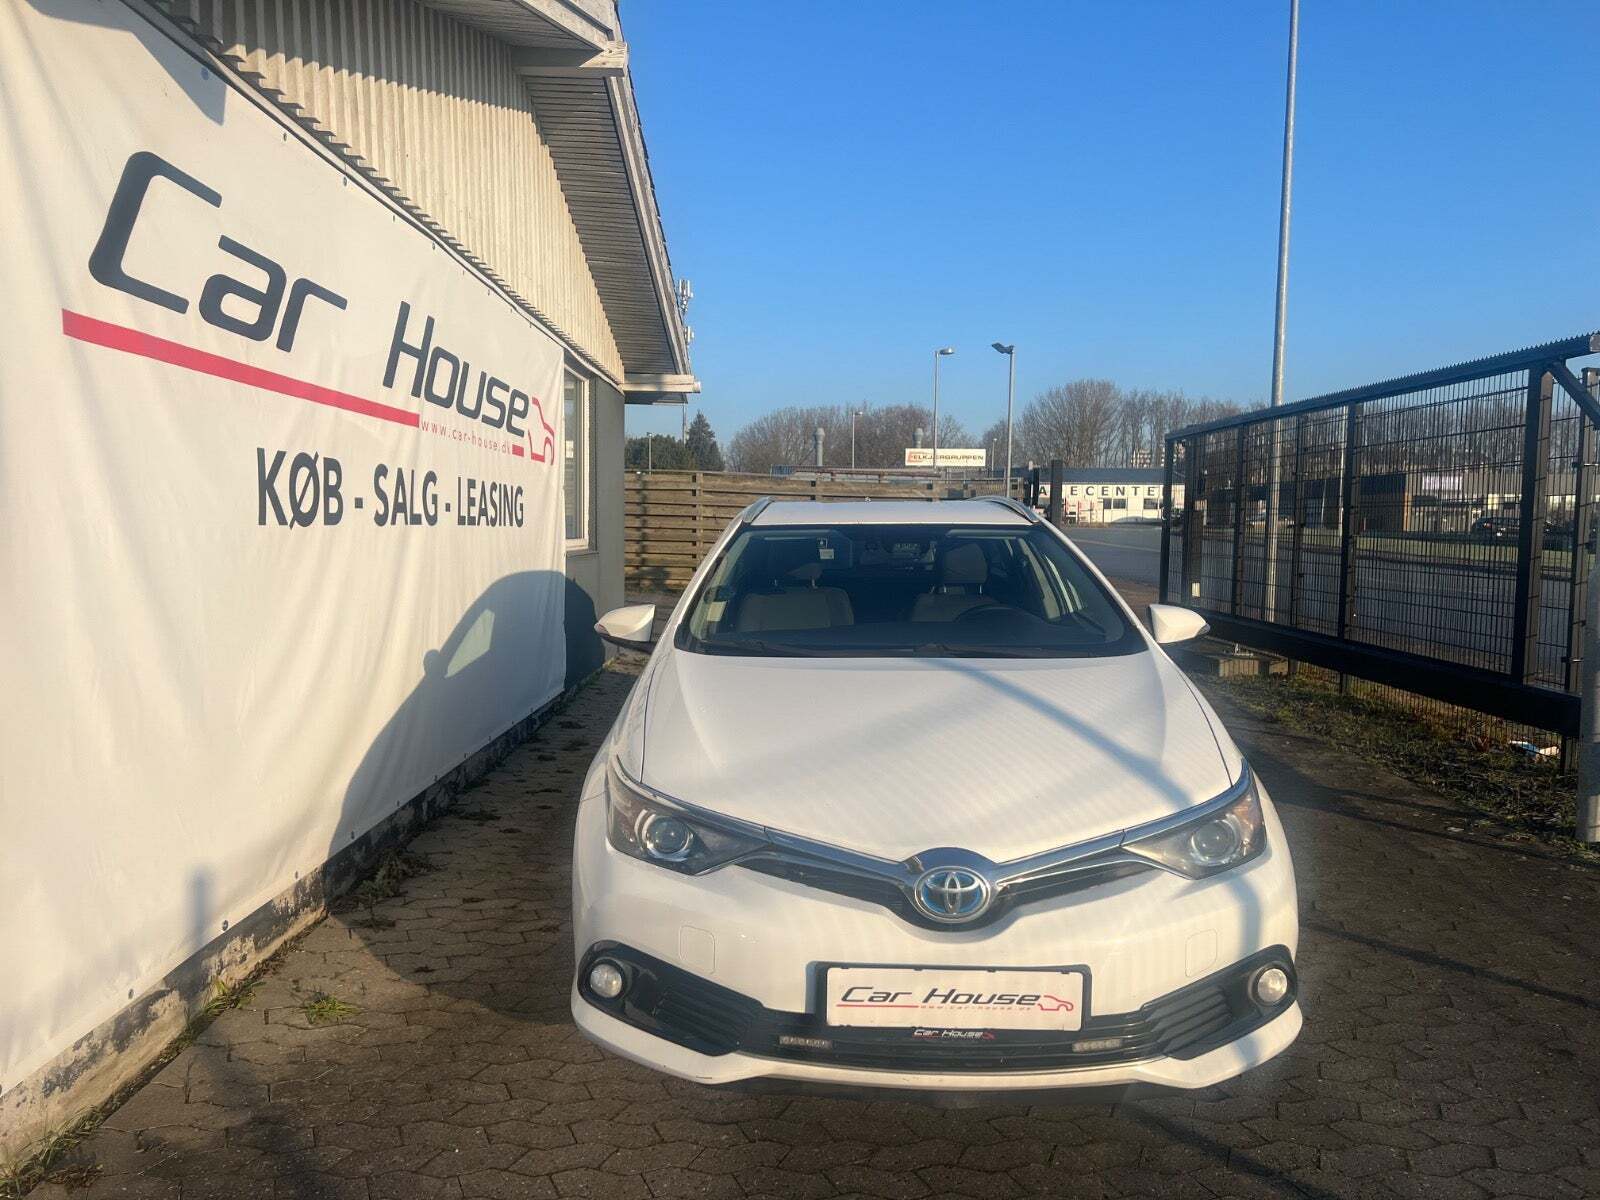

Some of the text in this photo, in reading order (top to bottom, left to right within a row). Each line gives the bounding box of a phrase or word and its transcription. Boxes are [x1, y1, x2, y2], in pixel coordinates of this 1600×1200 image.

[88, 150, 530, 438] Car House
[420, 419, 512, 456] www.car-house.dk
[256, 446, 344, 530] KØB
[373, 463, 439, 527] SALG
[456, 475, 524, 529] LEASING
[1039, 485, 1164, 497] AECENTE
[840, 986, 1041, 1006] Car House
[913, 1028, 984, 1039] Car House
